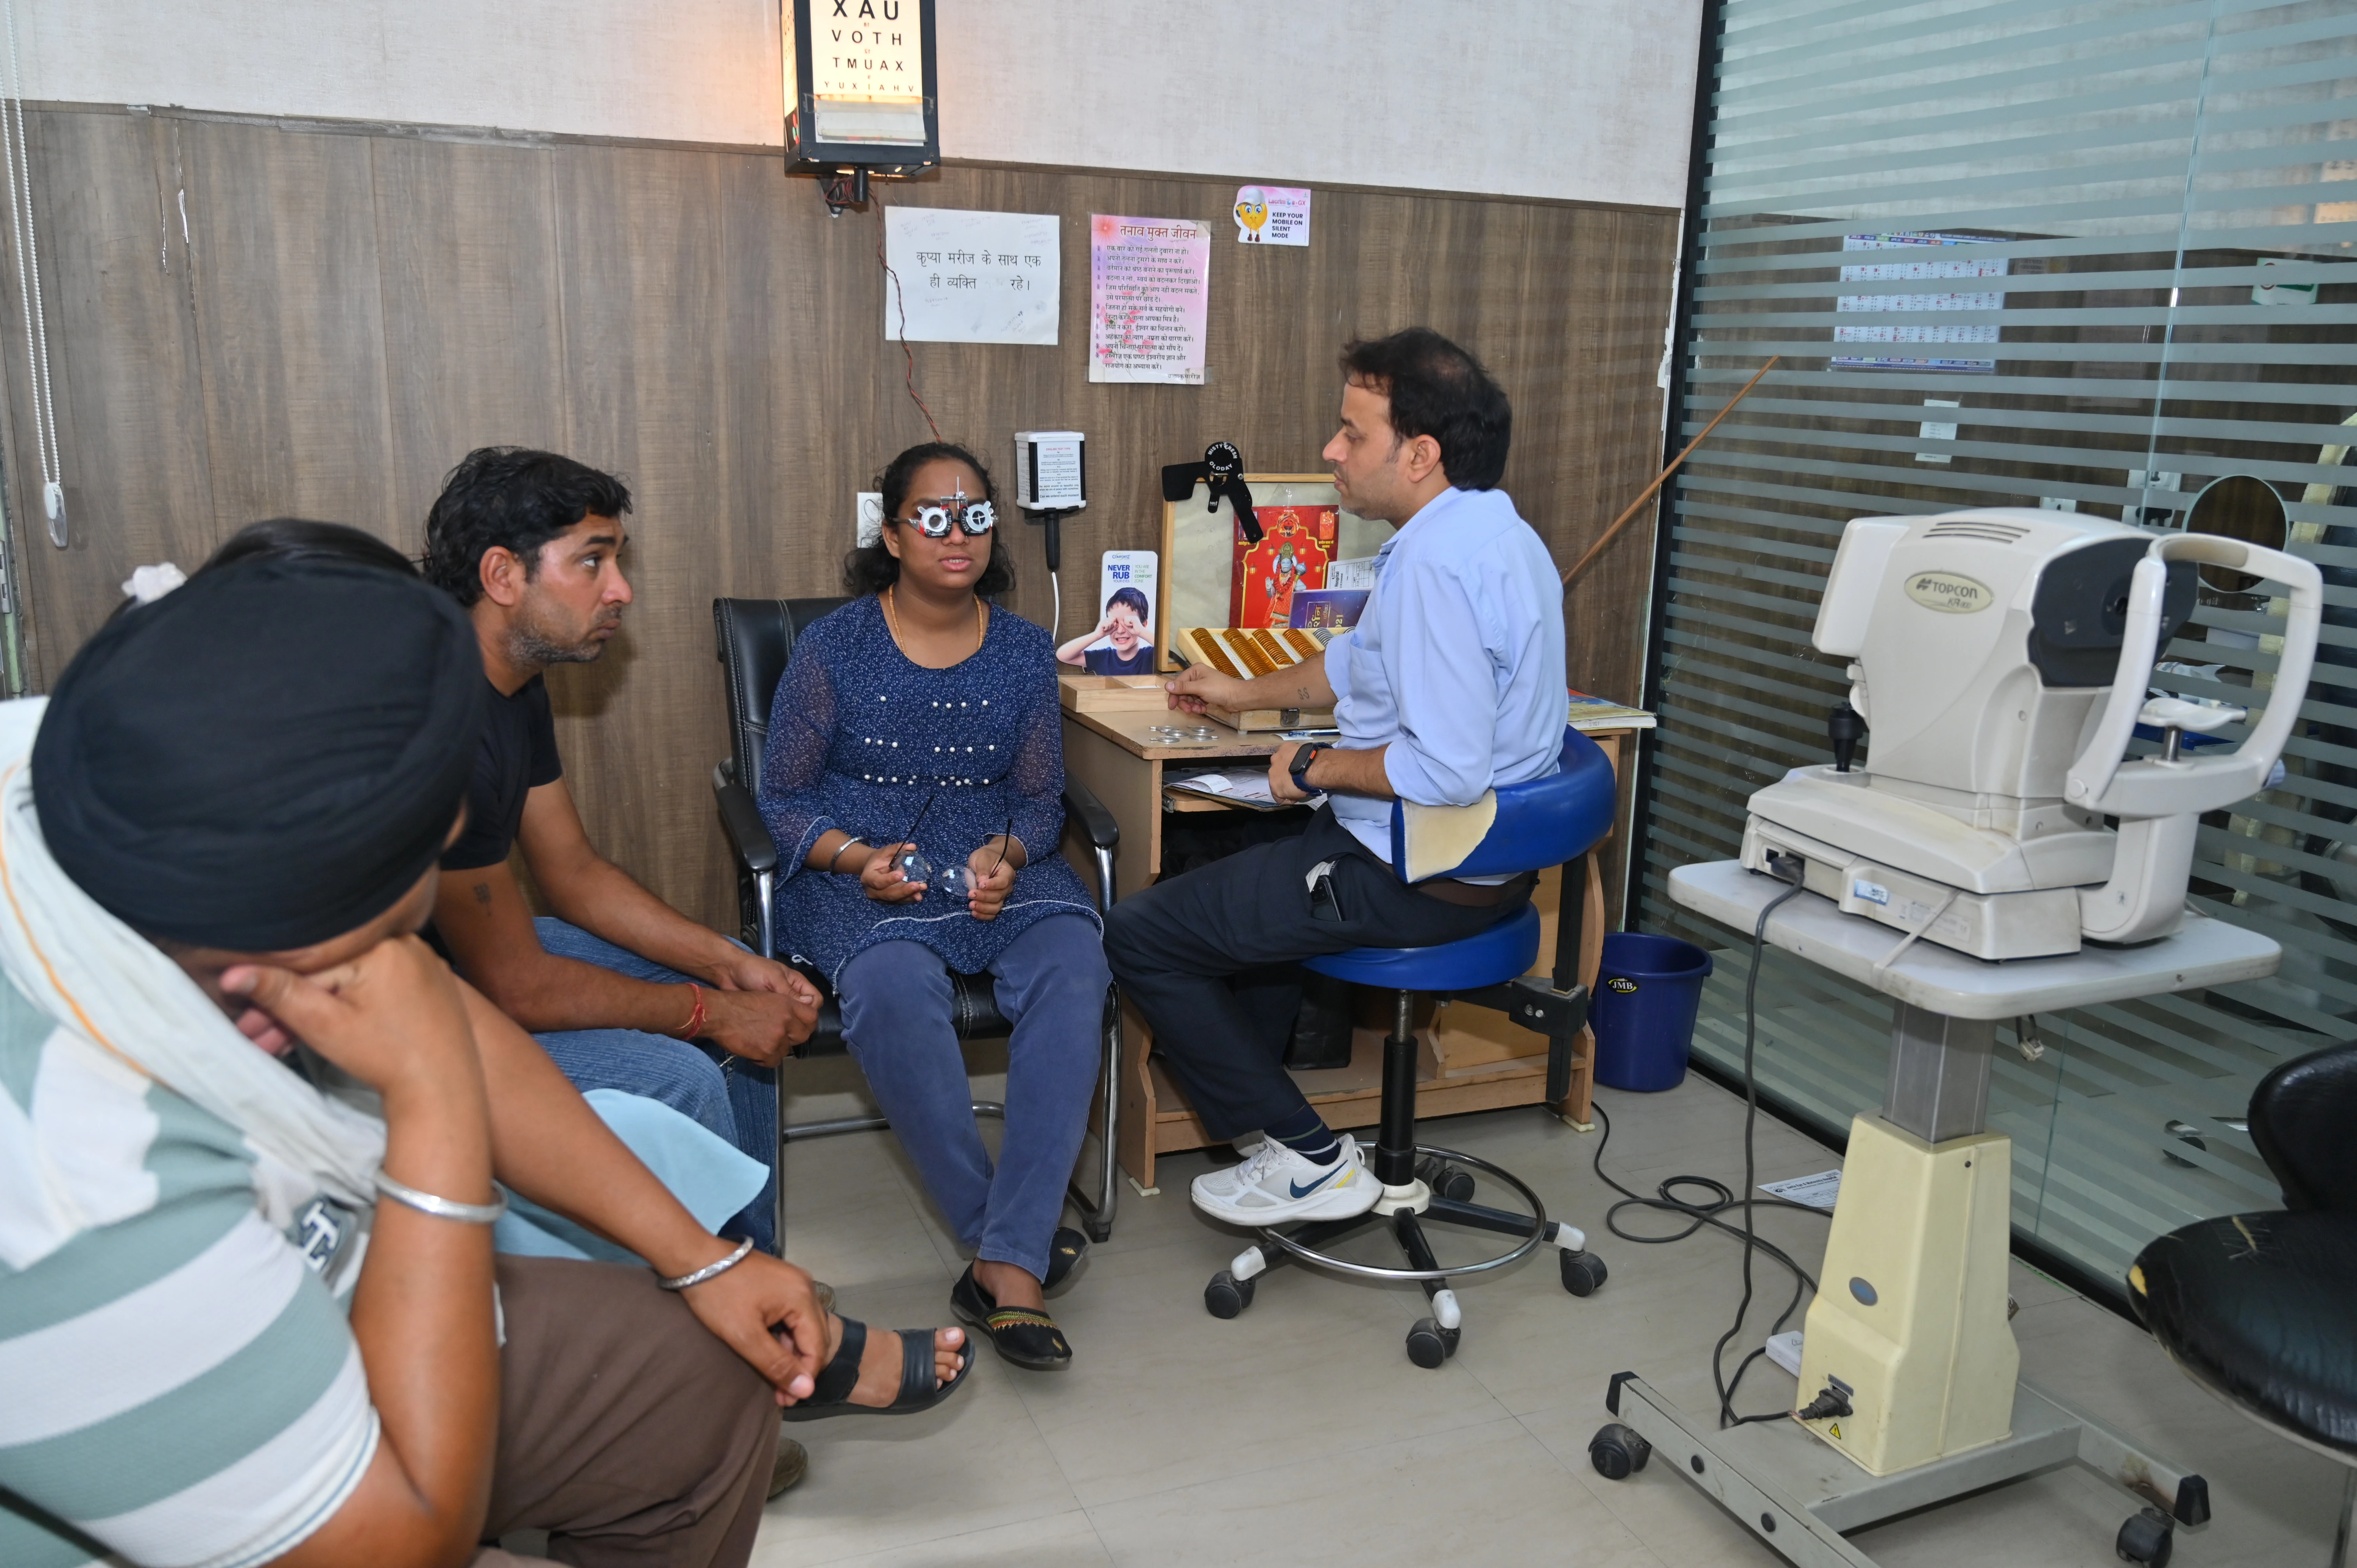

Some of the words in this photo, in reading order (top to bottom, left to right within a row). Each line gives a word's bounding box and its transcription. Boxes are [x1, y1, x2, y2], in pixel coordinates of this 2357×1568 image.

[1120, 226, 1145, 236] तनाव
[1147, 227, 1169, 241] मुक्त
[1171, 225, 1197, 239] जीवन
[1136, 245, 1143, 253] गई
[948, 249, 975, 265] मरीज
[982, 250, 991, 265] के
[998, 254, 1018, 266] साथ
[1025, 256, 1041, 268] एक
[930, 273, 940, 288] ही
[947, 275, 977, 289] व्यक्ति
[1121, 303, 1127, 311] हो
[1148, 304, 1154, 312] के
[1208, 444, 1223, 456] MISTY
[1931, 581, 1978, 599] TOPCON
[1612, 981, 1633, 991] JMB
